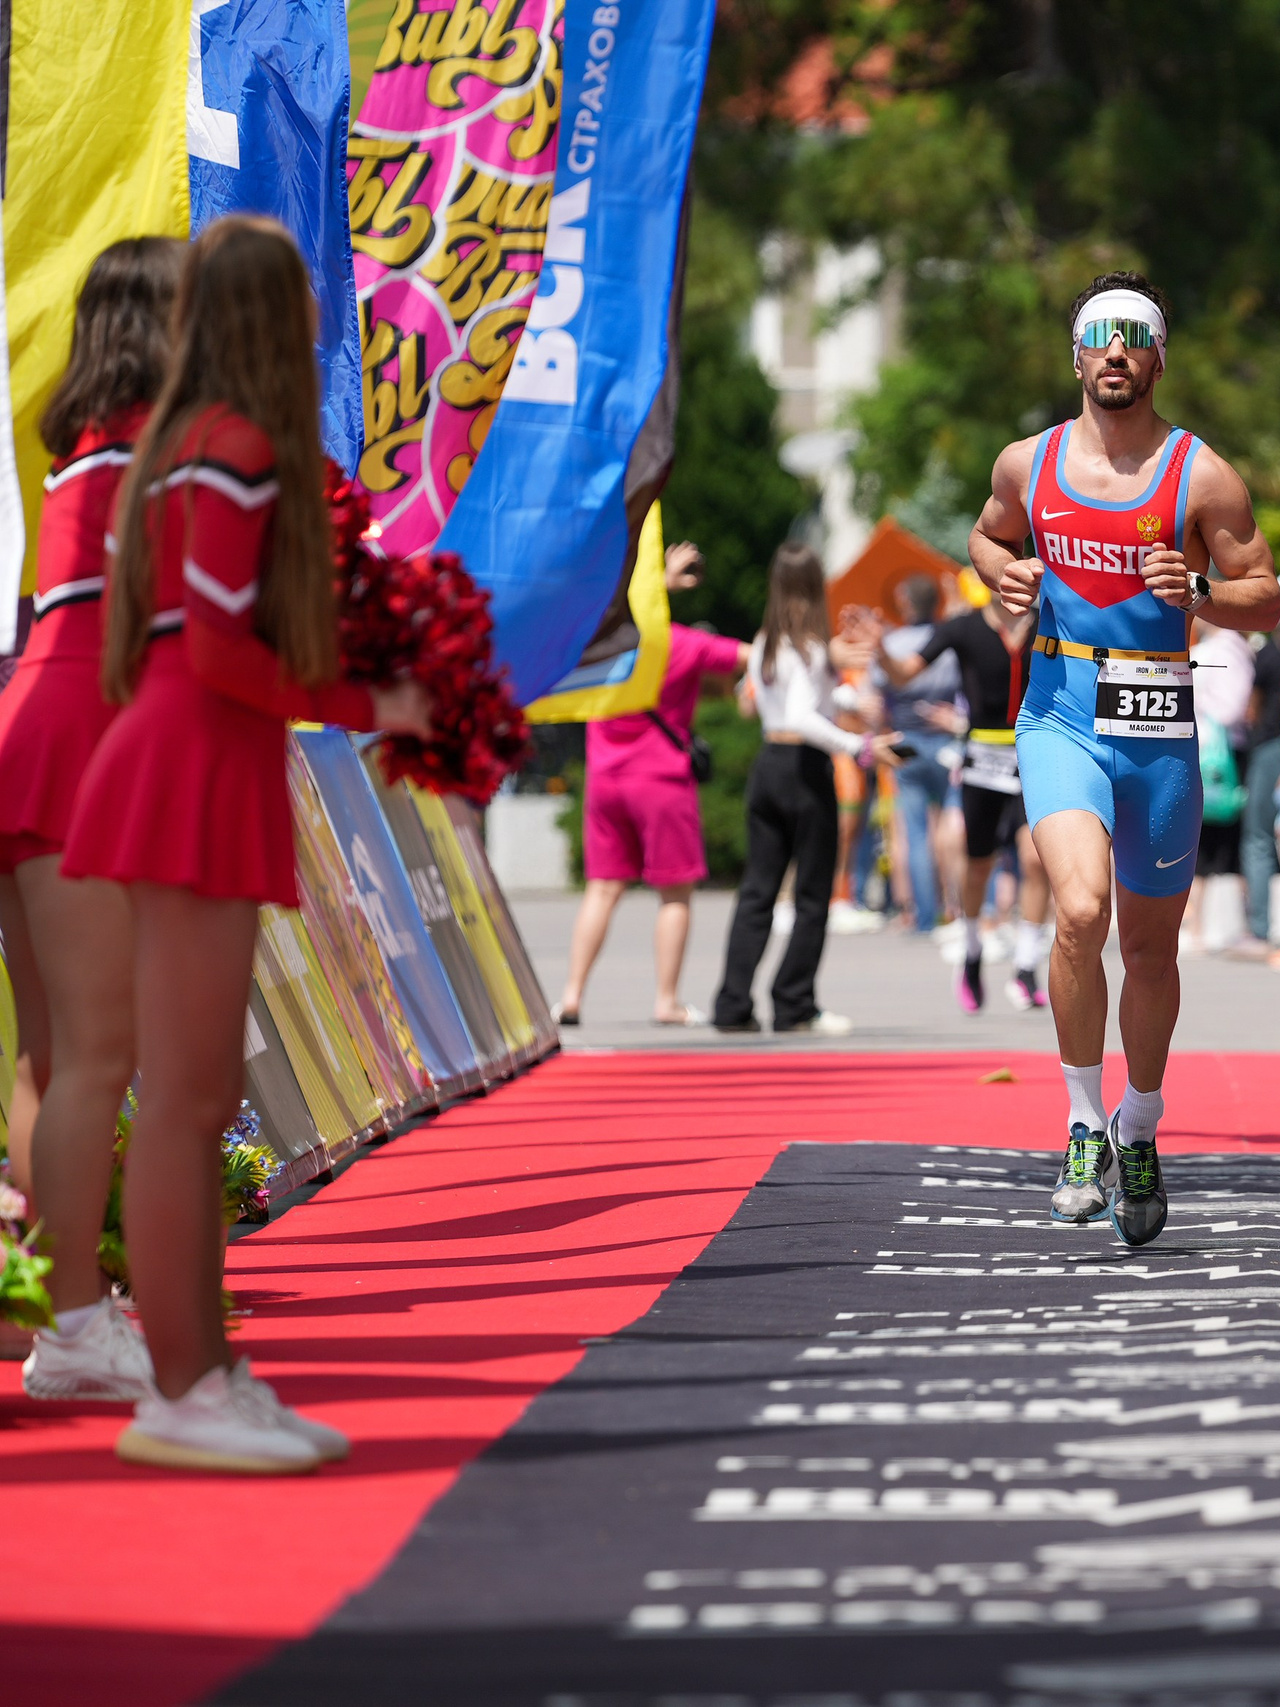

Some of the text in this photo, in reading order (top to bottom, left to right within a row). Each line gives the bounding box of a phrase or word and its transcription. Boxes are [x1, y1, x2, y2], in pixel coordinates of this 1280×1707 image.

[567, 0, 622, 174] СТРАХОВ
[1154, 667, 1168, 675] STAR
[1117, 689, 1178, 718] 3125
[1128, 724, 1166, 732] MAGOMED
[871, 1264, 1149, 1275] IRON
